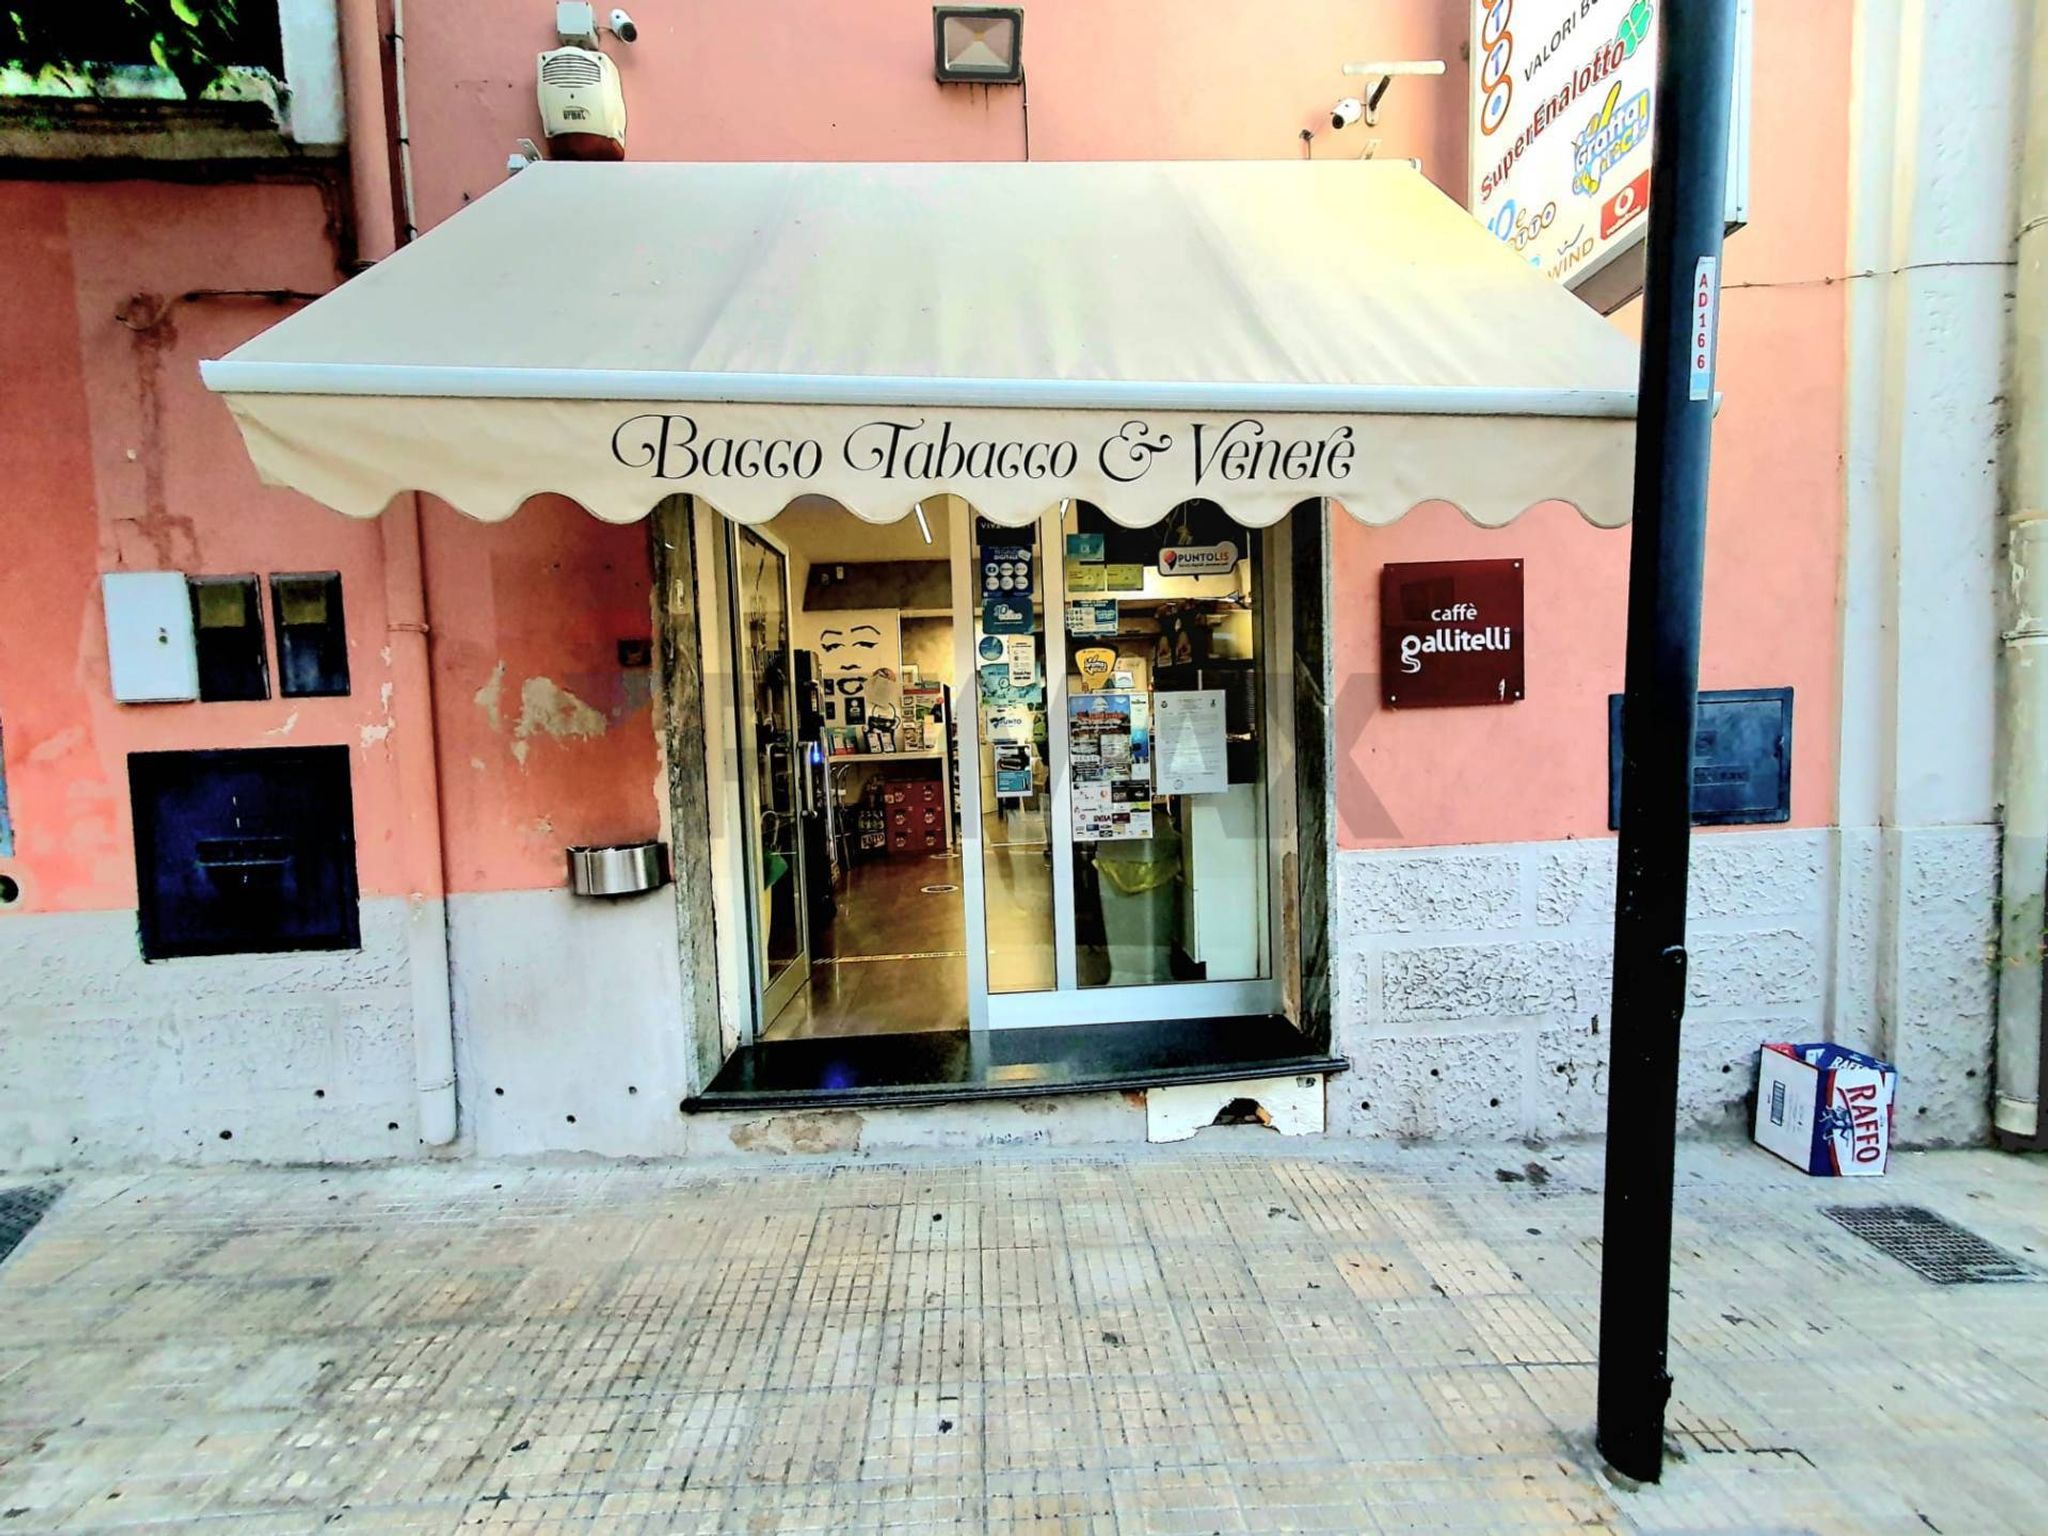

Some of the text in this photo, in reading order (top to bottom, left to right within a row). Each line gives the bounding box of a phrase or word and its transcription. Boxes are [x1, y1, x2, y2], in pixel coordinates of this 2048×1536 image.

[1524, 12, 1577, 82] VALORI
[611, 414, 1355, 486] Bacco Tabacco & Venere
[1431, 603, 1478, 622] caffè
[1400, 626, 1511, 674] gallitelli
[1845, 1084, 1881, 1164] RAFFO
